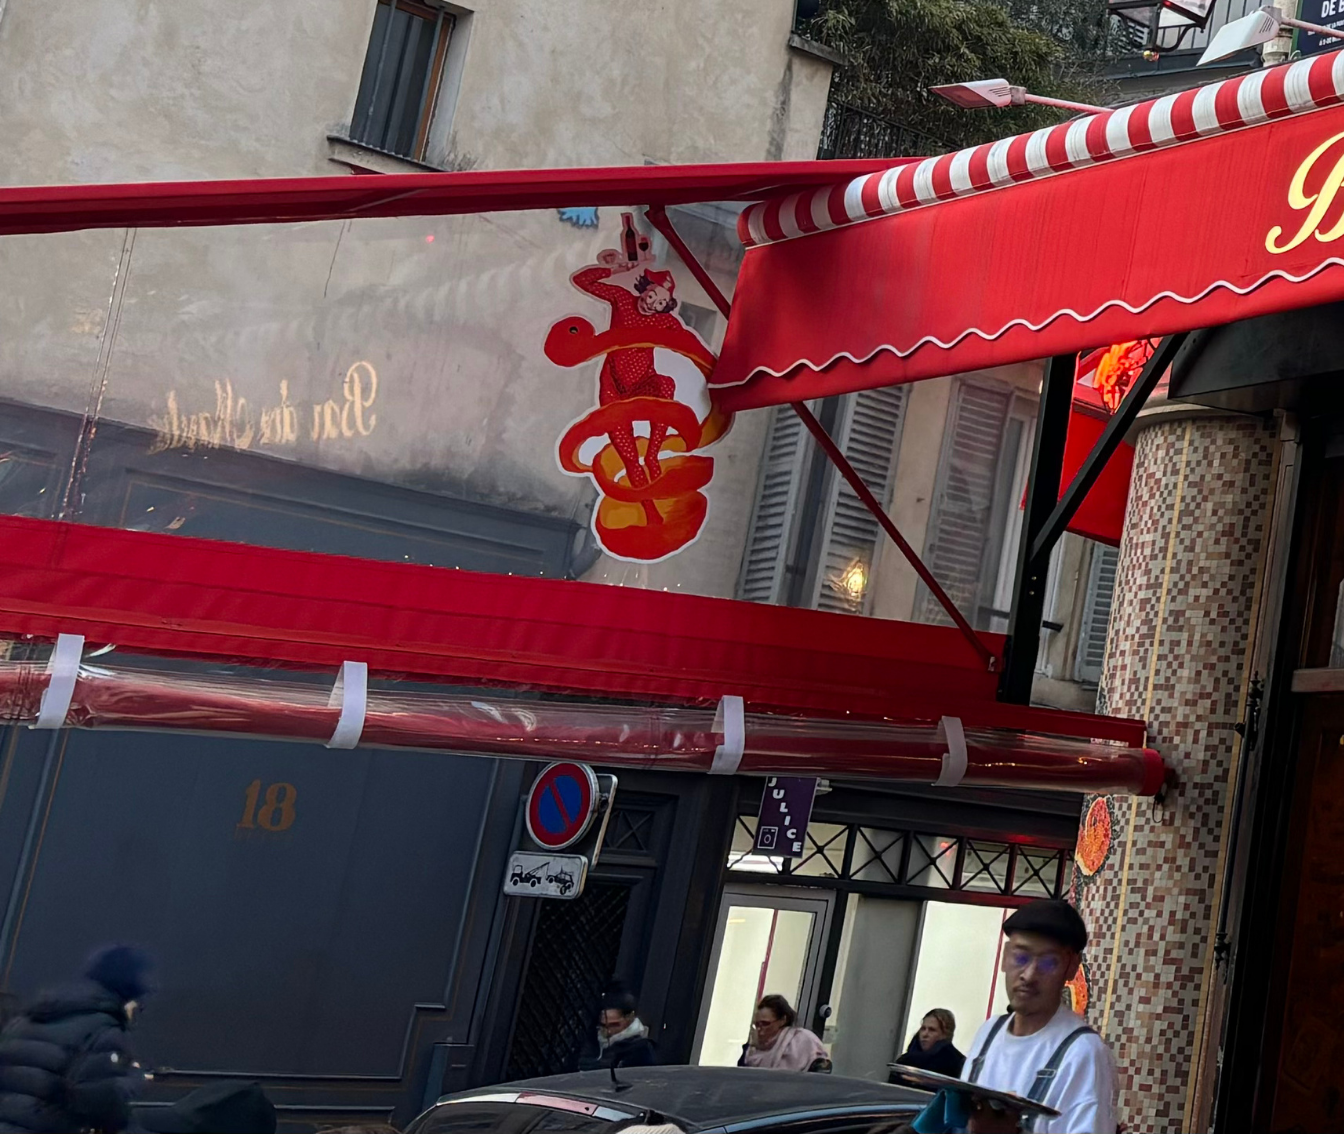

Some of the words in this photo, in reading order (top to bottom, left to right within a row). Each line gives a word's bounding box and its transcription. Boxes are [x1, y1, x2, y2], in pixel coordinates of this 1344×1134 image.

[1321, 0, 1336, 18] DE
[236, 778, 297, 832] 18
[768, 777, 802, 852] JULICE
